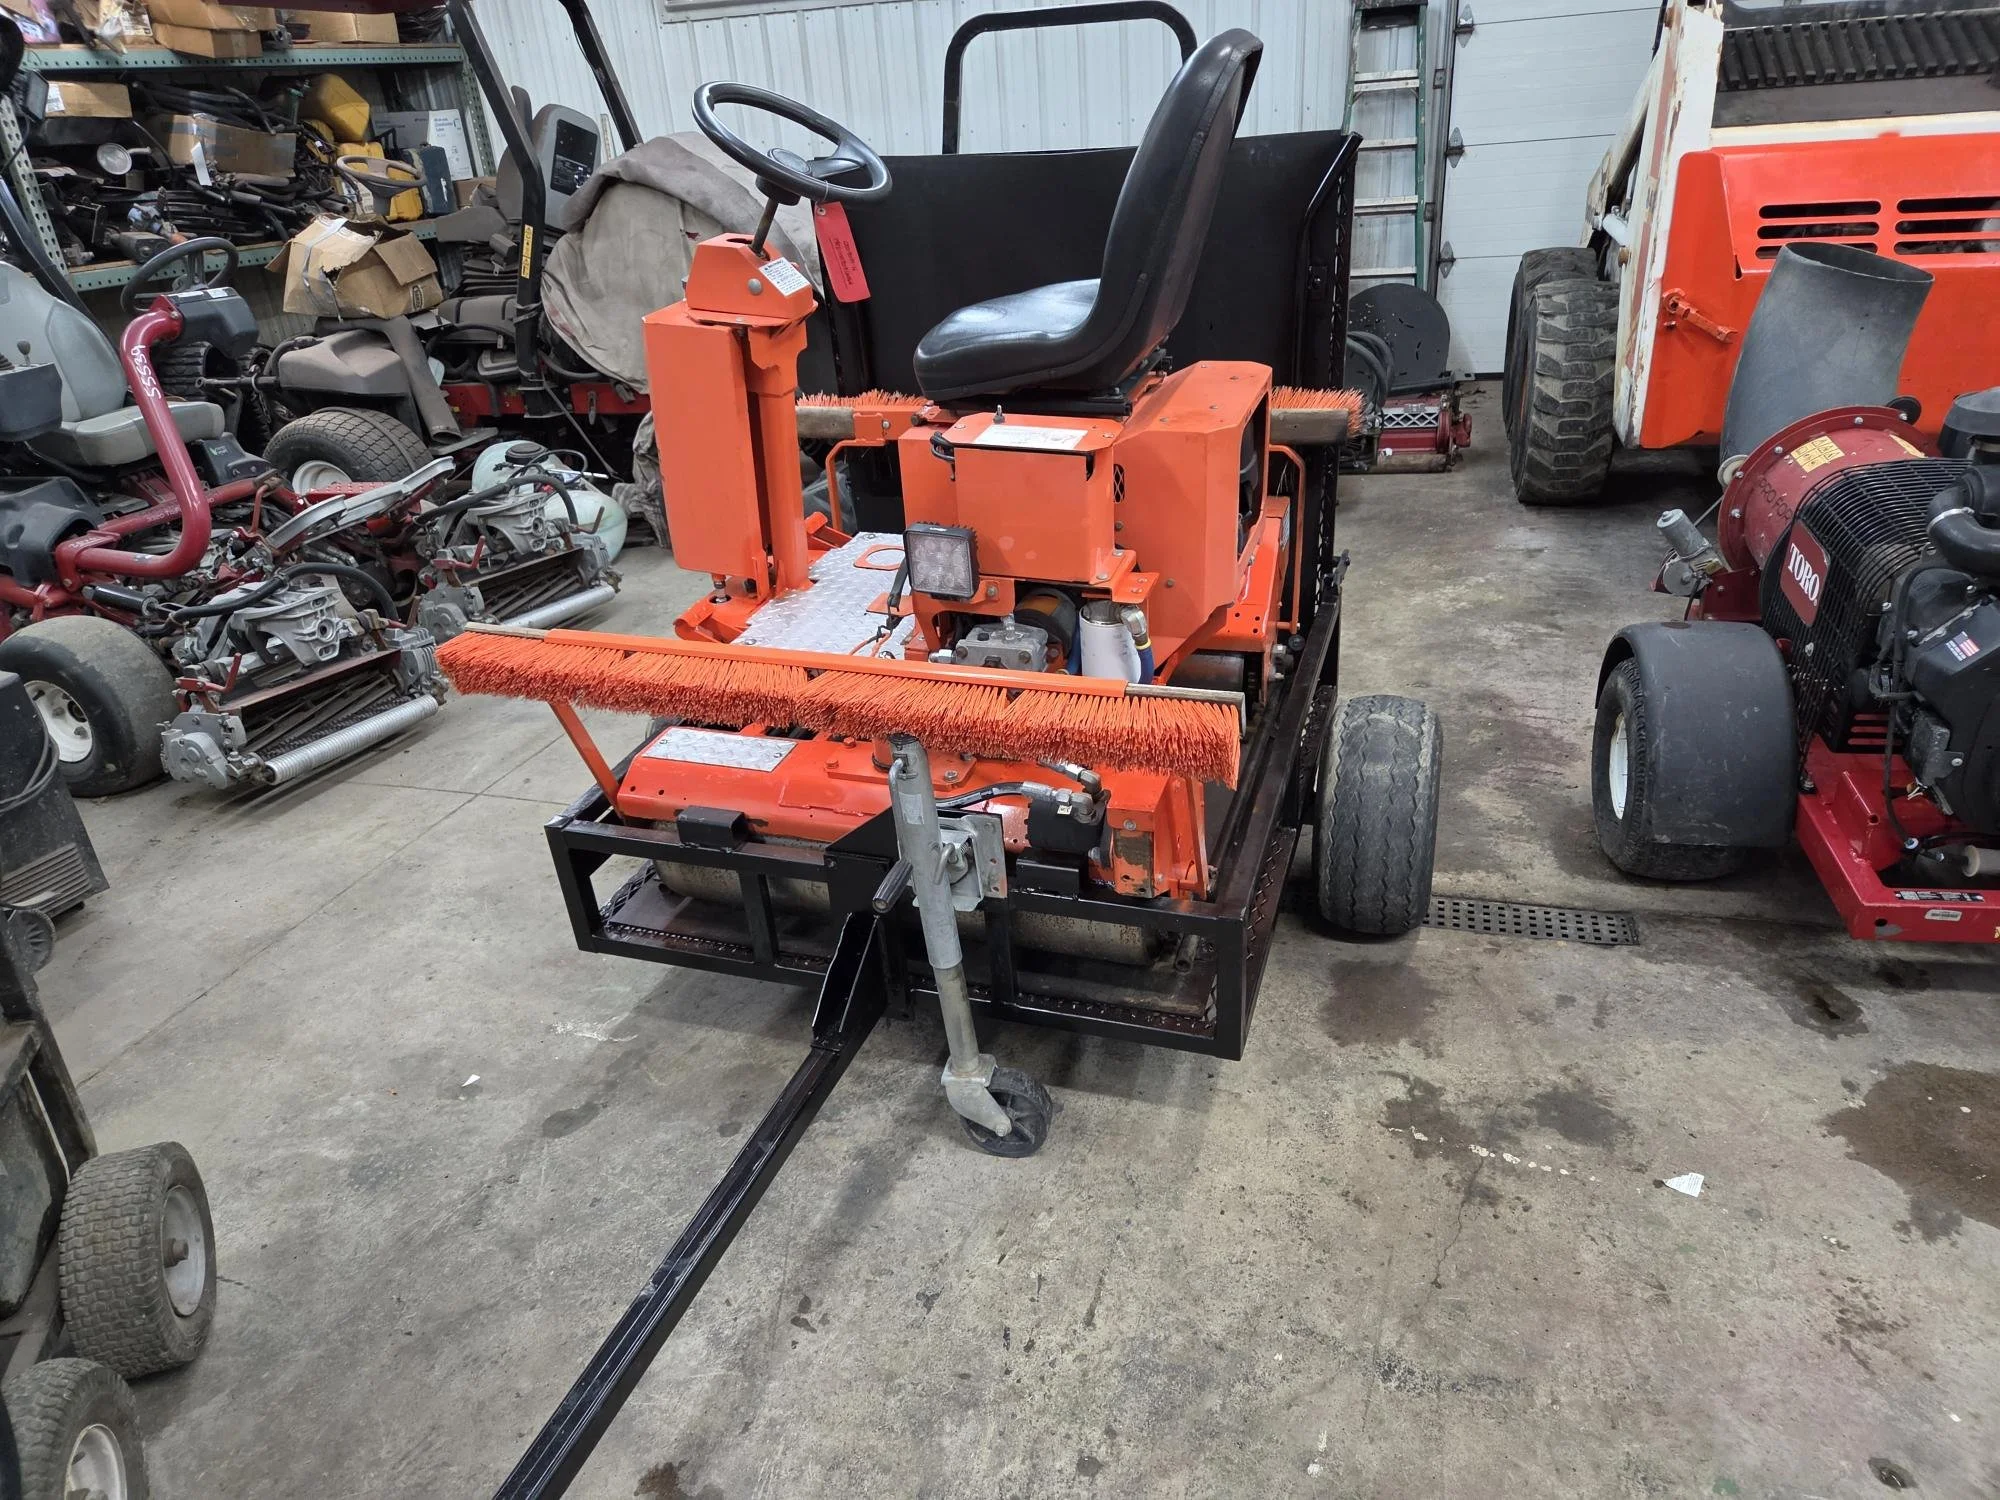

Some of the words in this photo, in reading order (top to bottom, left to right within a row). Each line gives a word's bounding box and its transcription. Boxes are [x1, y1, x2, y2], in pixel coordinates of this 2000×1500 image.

[1758, 478, 1777, 503] PRO
[1772, 496, 1794, 521] FOR
[1788, 543, 1820, 602] TORO
